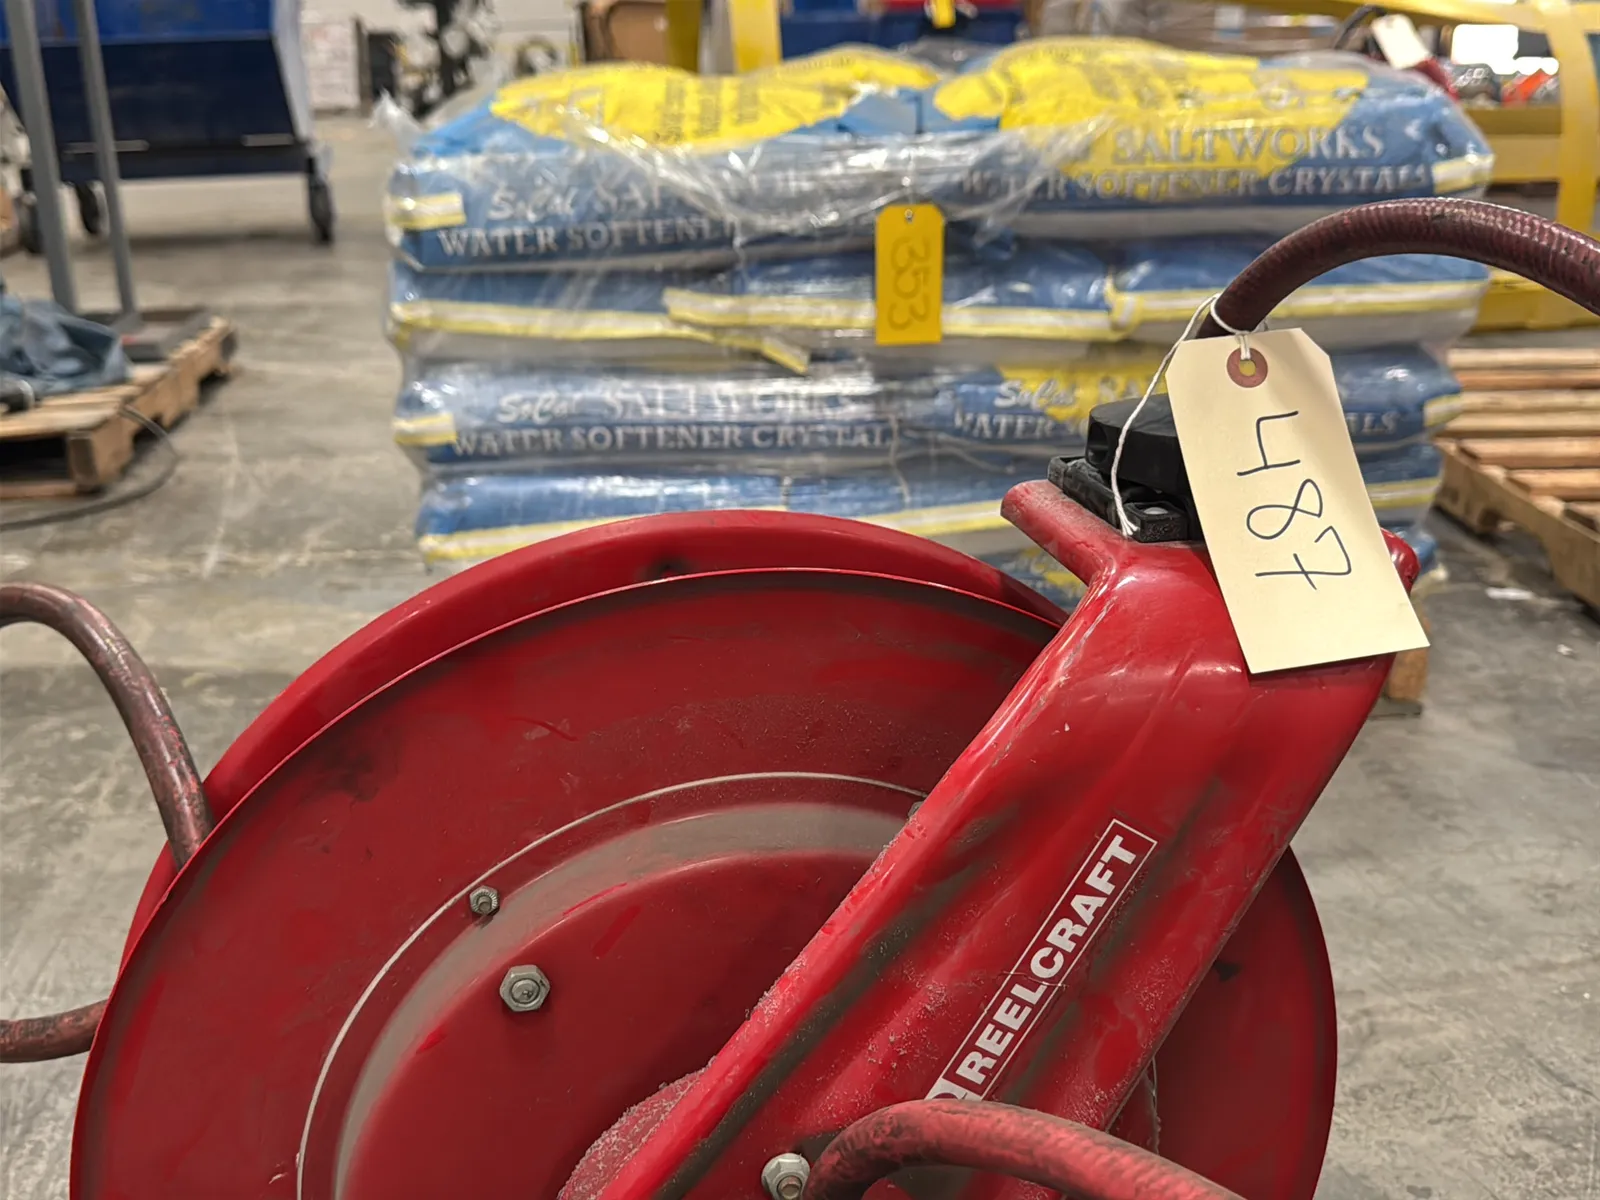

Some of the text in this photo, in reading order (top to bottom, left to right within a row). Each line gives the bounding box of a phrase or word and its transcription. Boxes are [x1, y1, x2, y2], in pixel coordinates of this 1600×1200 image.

[1112, 122, 1385, 166] SALTWORKS
[962, 170, 1068, 200] WTR
[1268, 163, 1426, 196] CRYSTALS
[437, 214, 742, 258] WATER SOFTEN
[454, 422, 897, 457] WATER SOFTENER CRYSTAL
[953, 404, 1055, 441] WATER
[1236, 410, 1352, 591] 487
[955, 834, 1136, 1085] REELCRAFT
